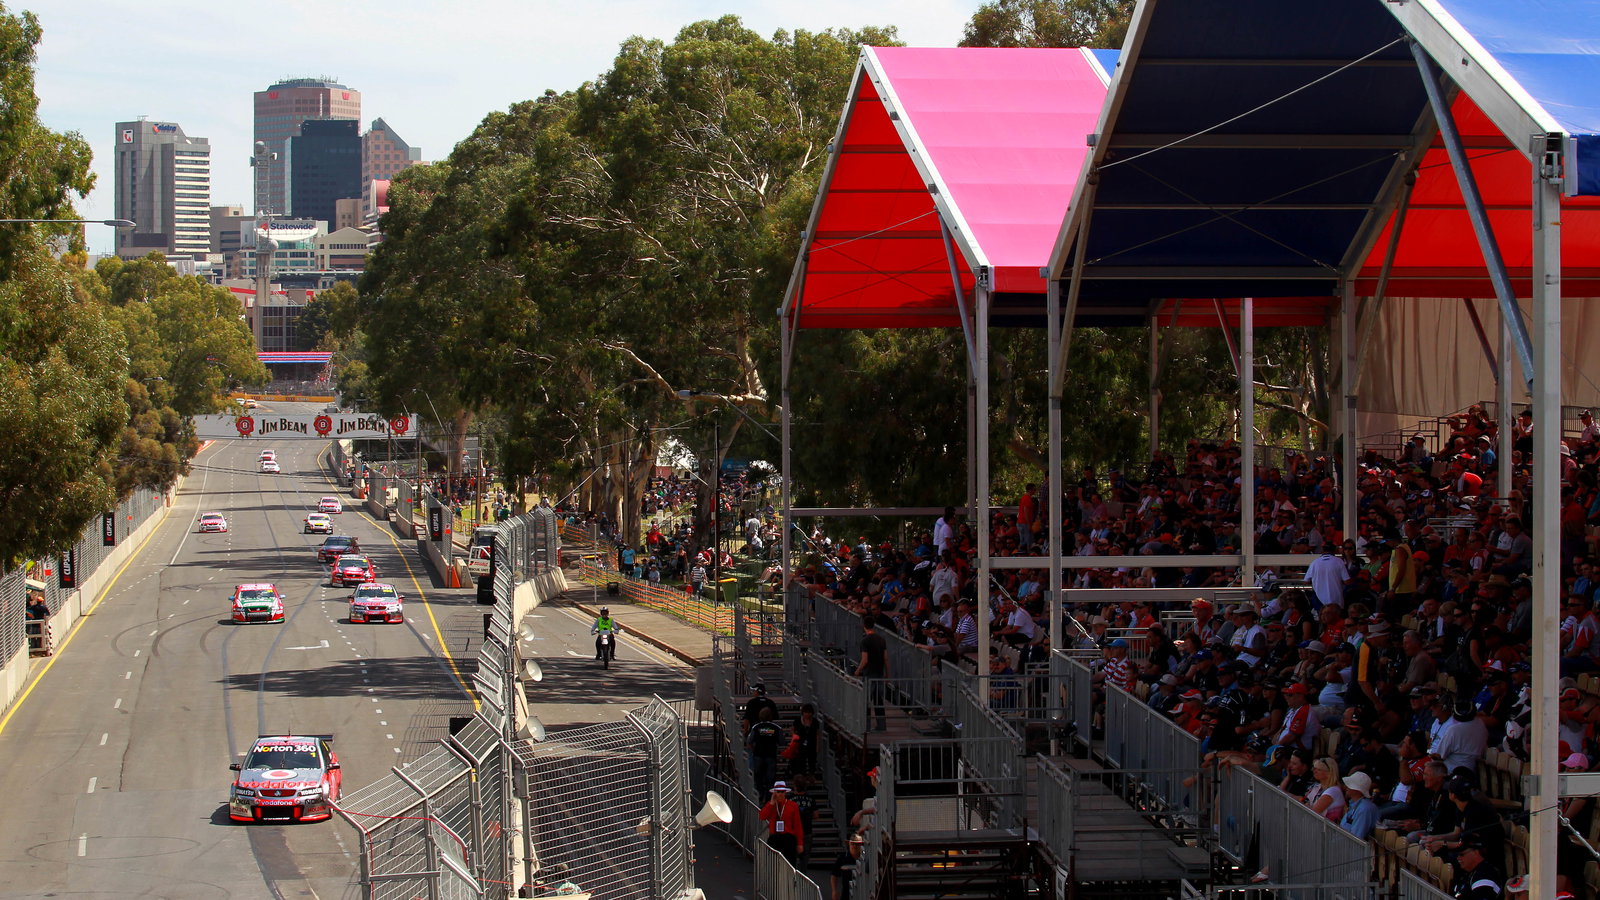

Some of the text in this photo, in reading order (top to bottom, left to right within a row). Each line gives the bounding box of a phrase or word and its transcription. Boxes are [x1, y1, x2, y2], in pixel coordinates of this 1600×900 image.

[270, 222, 315, 230] Statewide
[258, 418, 308, 435] JIM BEAM
[337, 418, 356, 434] JIM
[62, 550, 71, 576] CLIPSAL
[294, 744, 316, 752] 360
